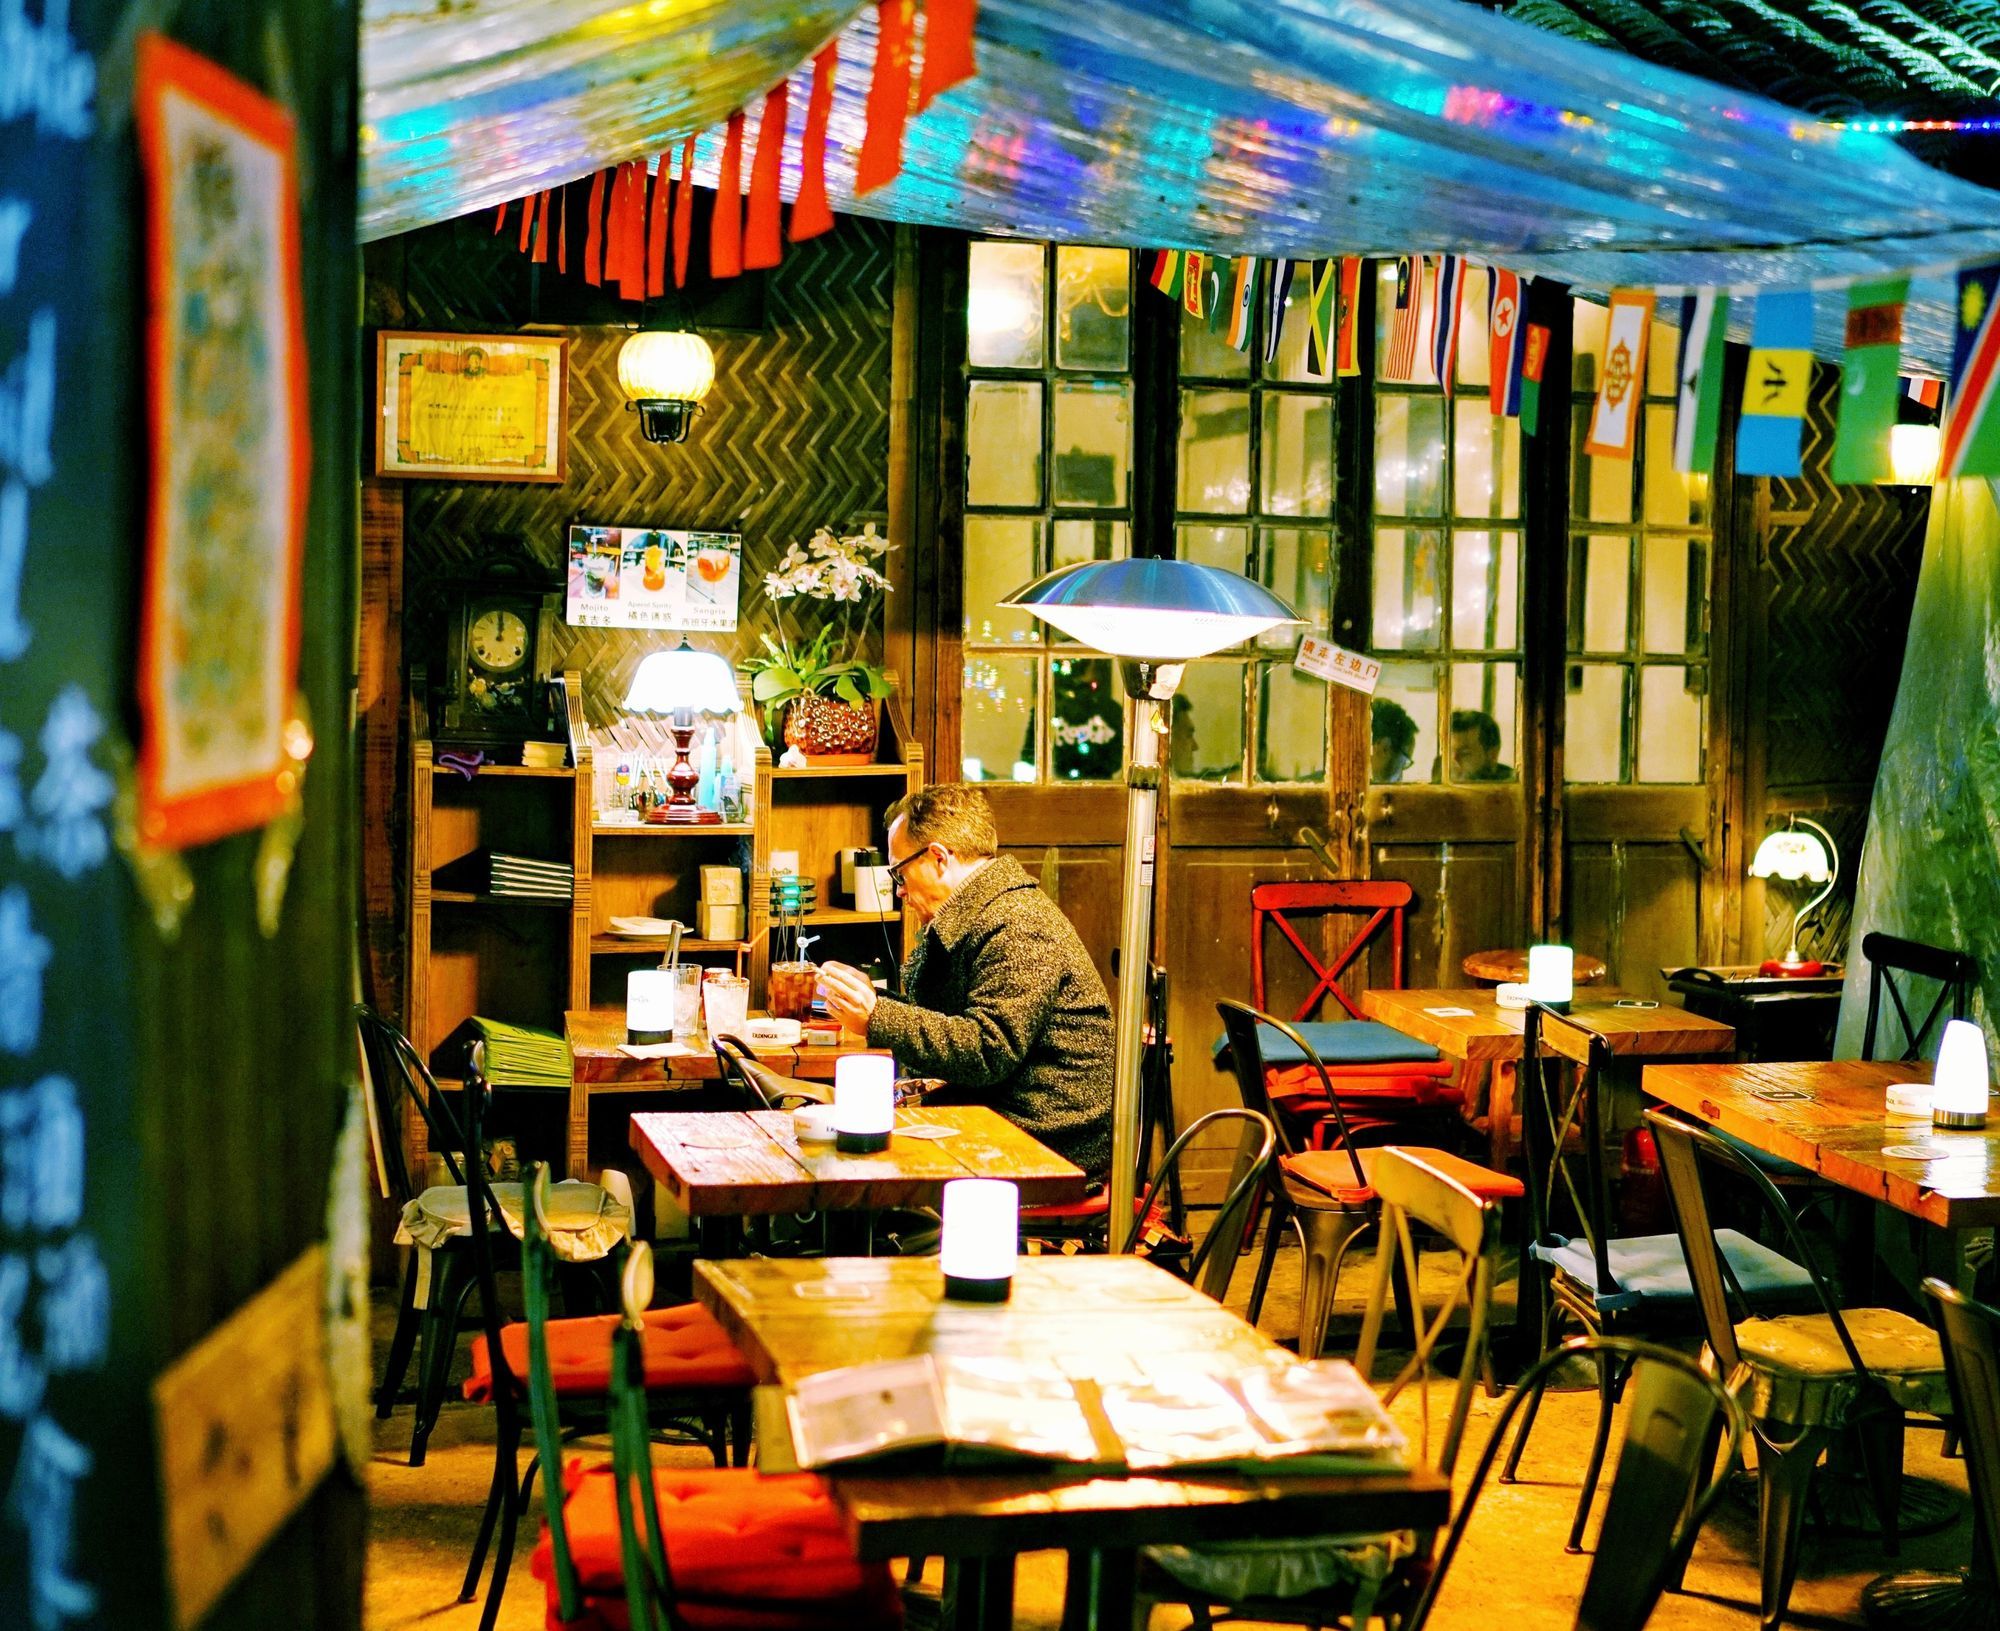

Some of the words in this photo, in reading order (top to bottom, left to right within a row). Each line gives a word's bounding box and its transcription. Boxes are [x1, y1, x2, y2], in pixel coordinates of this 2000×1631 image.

[580, 603, 609, 612] Mojito
[693, 607, 726, 616] Sangria
[1302, 639, 1379, 678] 请走左边门
